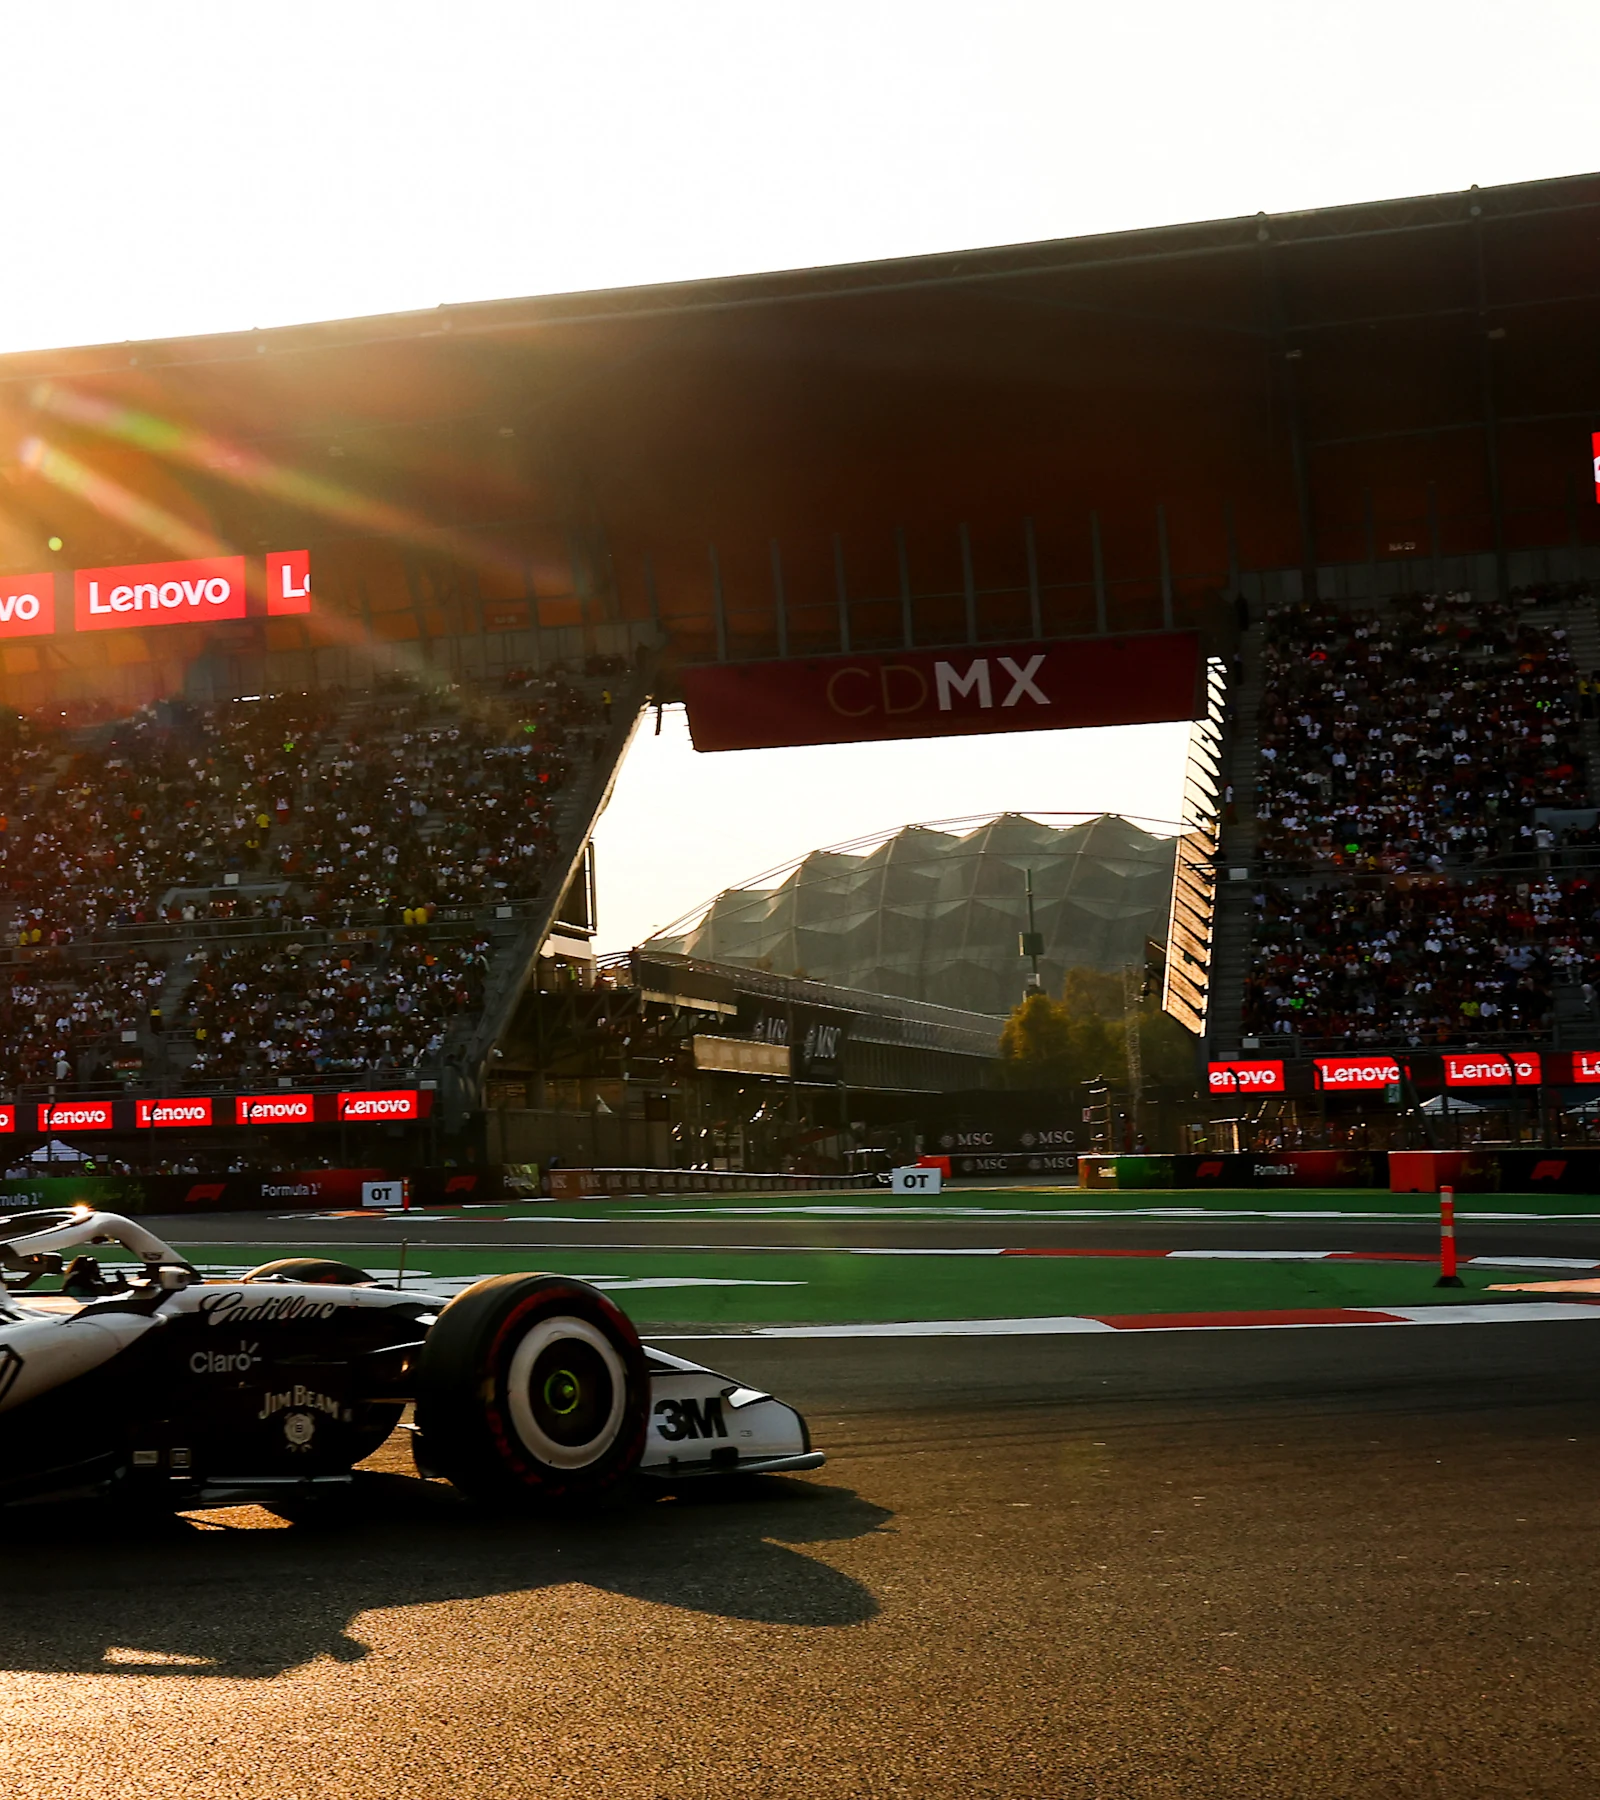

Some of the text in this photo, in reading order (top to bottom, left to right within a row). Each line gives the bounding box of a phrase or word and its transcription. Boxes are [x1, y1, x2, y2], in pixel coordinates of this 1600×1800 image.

[87, 576, 231, 615] Lenovo
[826, 655, 1052, 717] CDMX
[141, 1104, 206, 1122] Lenovo
[957, 1132, 994, 1146] MSC
[1038, 1130, 1075, 1144] MSC
[976, 1158, 1008, 1170] MSC
[1043, 1156, 1075, 1169] MSC
[904, 1174, 930, 1189] OT
[260, 1182, 310, 1199] Formula
[371, 1187, 392, 1202] OT
[198, 1291, 336, 1326] Cadillac
[258, 1384, 340, 1420] JIM BEAM
[654, 1396, 729, 1442] 3M
